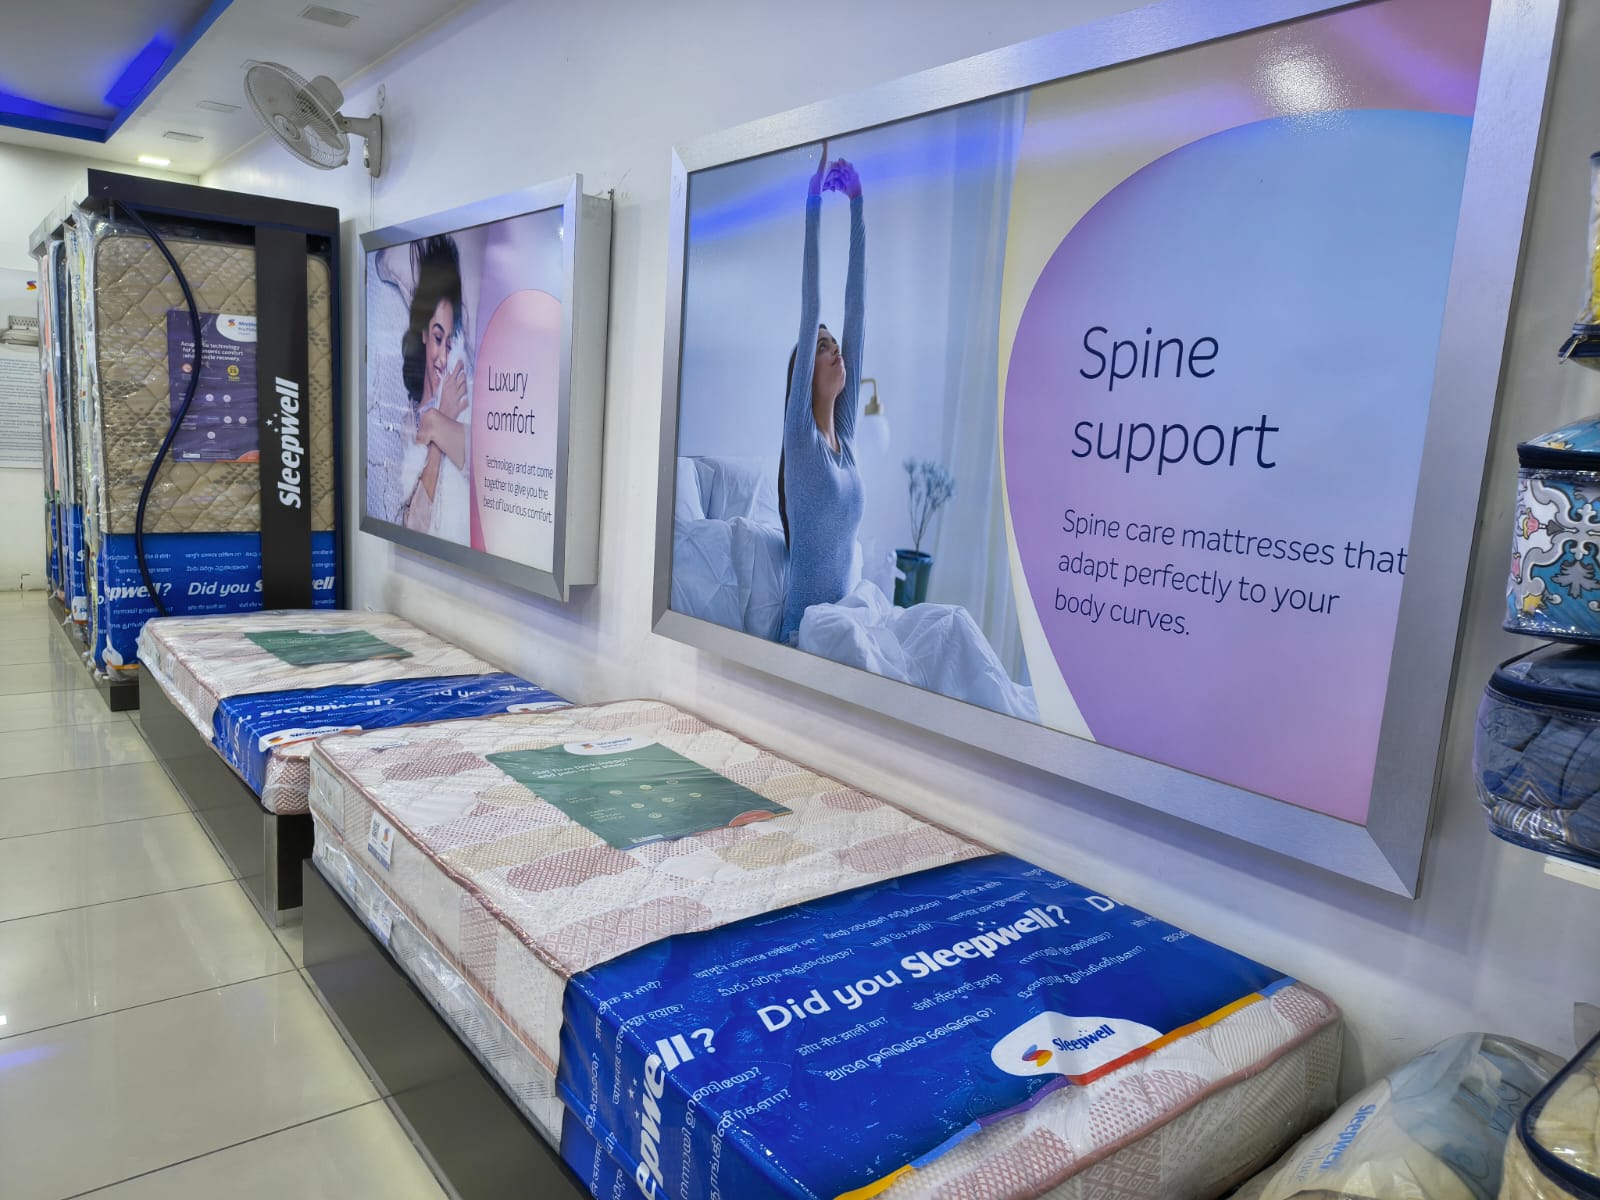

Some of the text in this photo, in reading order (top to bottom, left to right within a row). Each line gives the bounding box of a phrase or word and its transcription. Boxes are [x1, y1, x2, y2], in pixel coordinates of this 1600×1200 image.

[1079, 326, 1219, 392] Spine
[488, 365, 529, 399] Luxury
[486, 405, 536, 435] comfort
[274, 376, 304, 509] Sleepwell
[1071, 414, 1280, 476] support
[484, 476, 549, 500] together to give you the
[485, 455, 554, 480] Technology and art come
[483, 496, 495, 509] best
[495, 498, 503, 511] of
[502, 499, 527, 517] luxurious
[1062, 509, 1409, 576] Spine care mattresses that
[187, 581, 218, 596] Did
[220, 583, 250, 597] you
[1058, 552, 1341, 615] adapt perfectly to your
[1054, 587, 1191, 636] body curves.
[756, 989, 832, 1032] Did
[832, 968, 903, 1010] you
[901, 905, 1071, 978] Sleepwell?
[1052, 1024, 1116, 1052] Sleepwell
